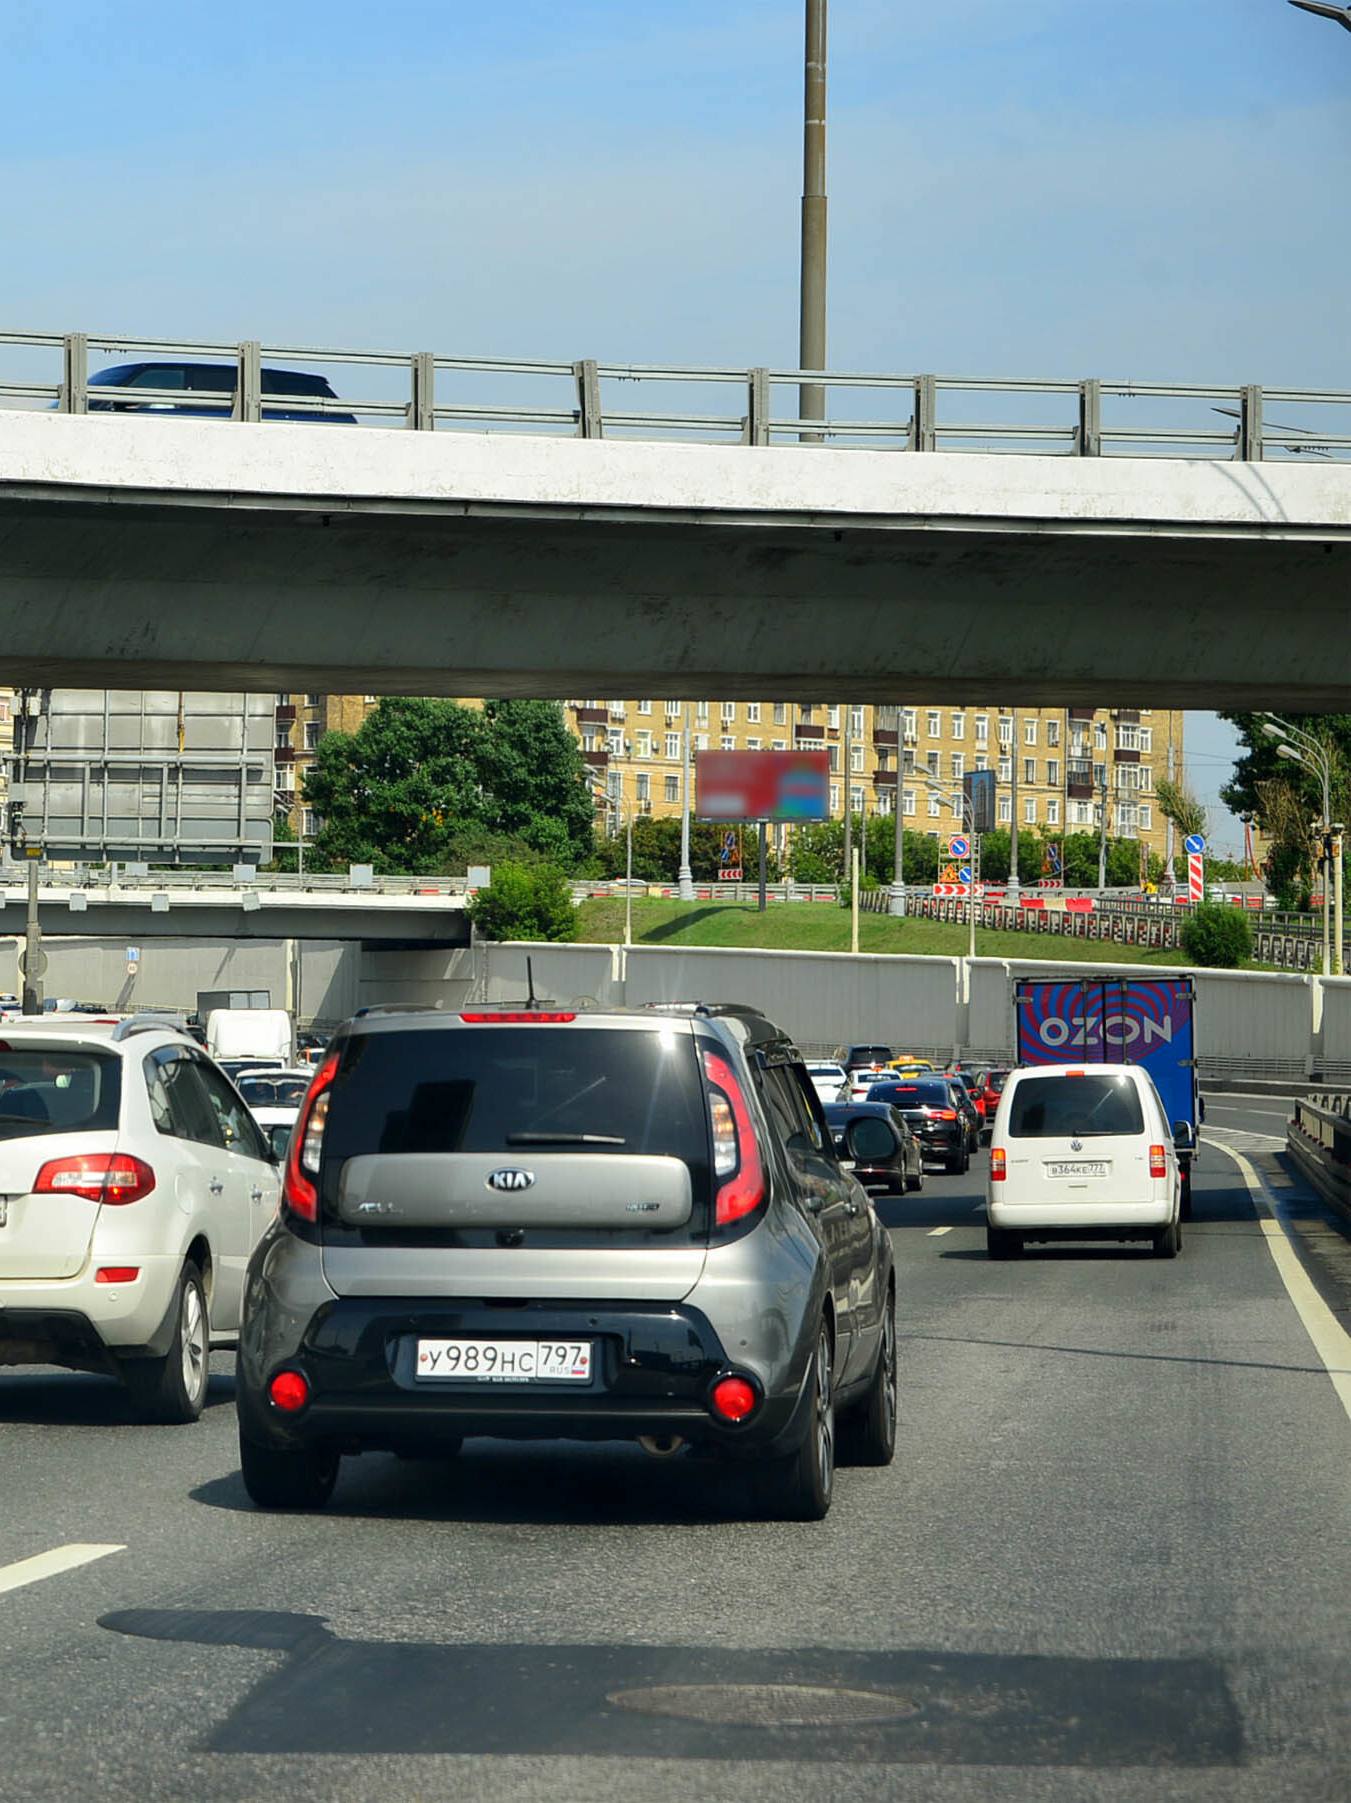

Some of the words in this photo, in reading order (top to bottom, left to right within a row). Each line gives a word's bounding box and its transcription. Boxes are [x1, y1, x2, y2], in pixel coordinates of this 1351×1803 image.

[1039, 1015, 1172, 1046] OZON
[493, 1171, 527, 1188] KIA
[541, 1345, 582, 1366] 797
[550, 1366, 570, 1375] RUS
